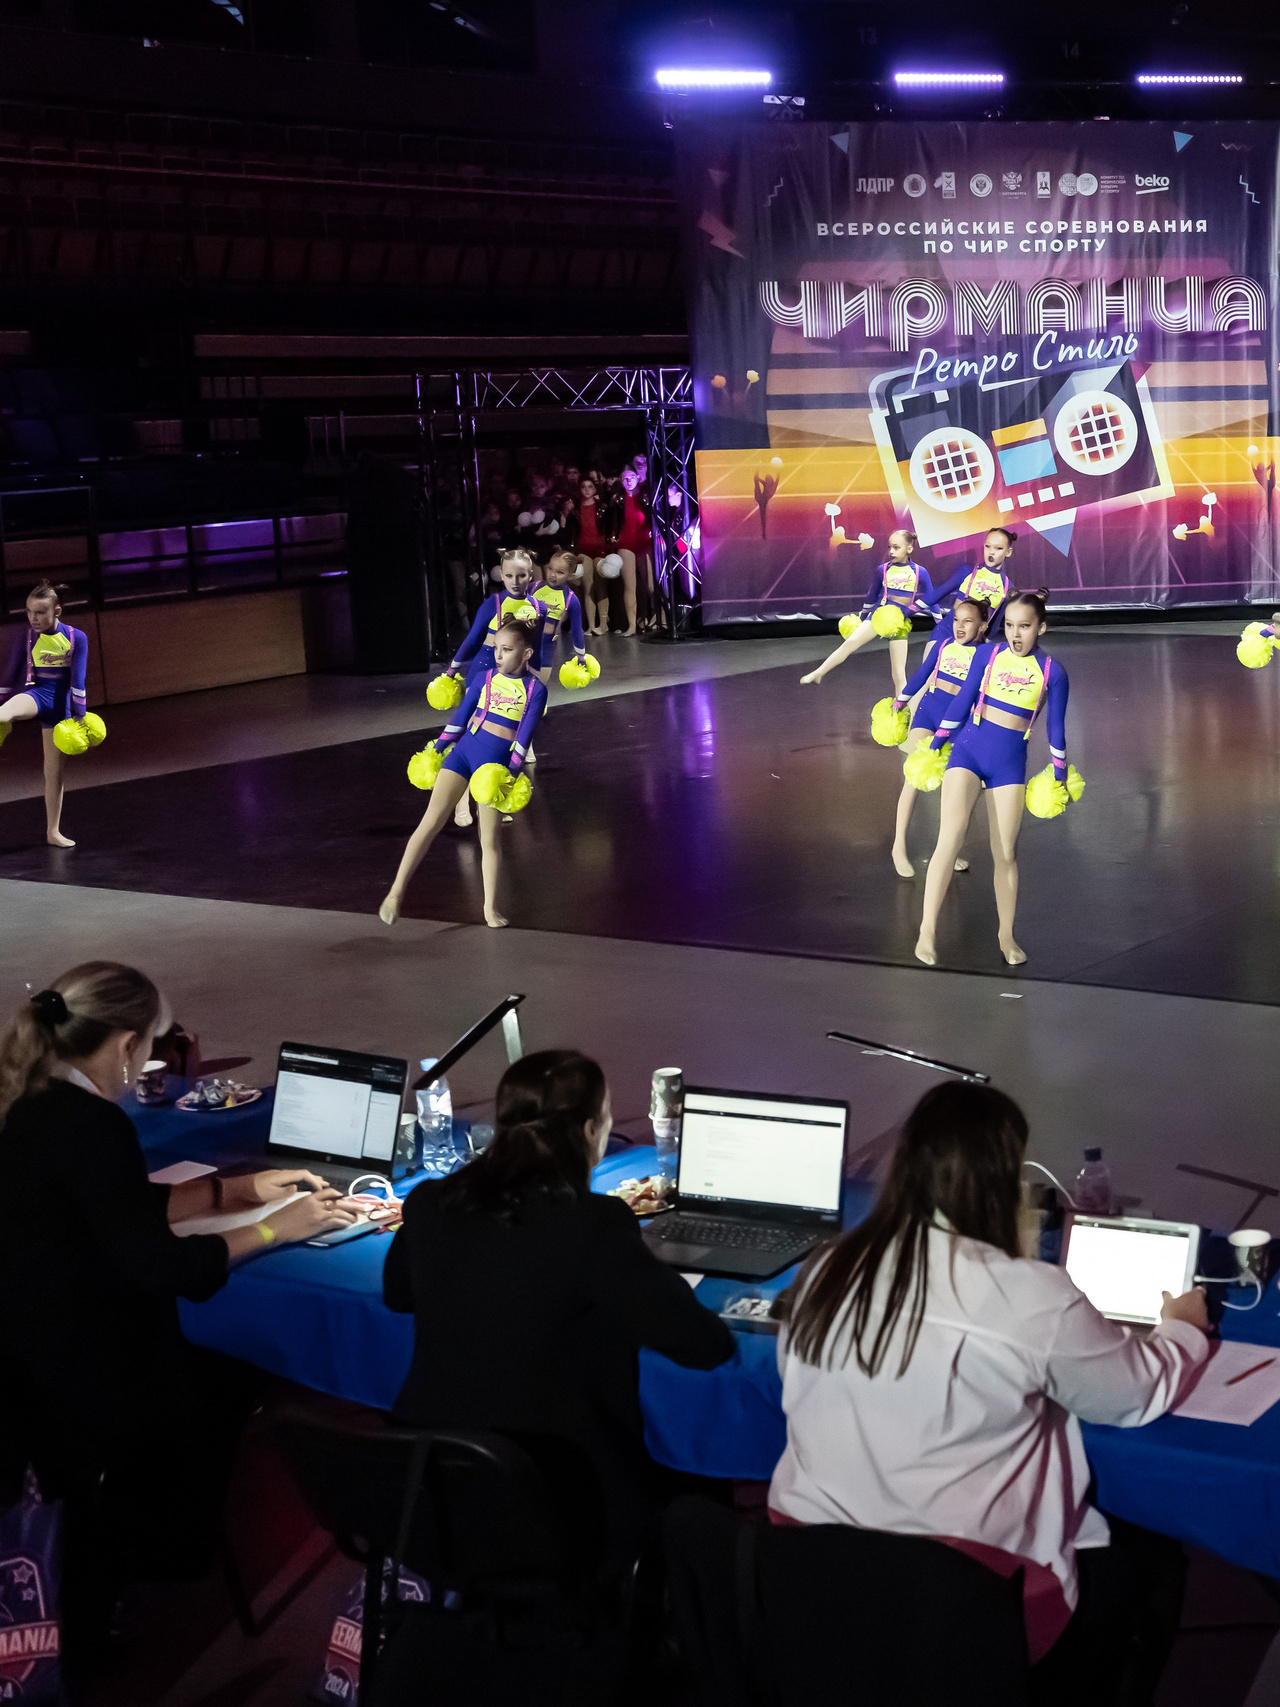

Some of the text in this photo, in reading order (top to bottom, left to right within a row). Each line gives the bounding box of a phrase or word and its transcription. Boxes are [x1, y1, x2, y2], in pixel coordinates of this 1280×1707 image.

[856, 177, 895, 195] ЛДПР
[1135, 173, 1171, 187] beko
[816, 218, 1208, 238] ВСЕРОССИЙСКИЕ СОРЕВНОВАНИЯ
[923, 238, 1107, 254] ПО ЧИР СПОРТУ
[910, 329, 1139, 390] Ретро Стиль
